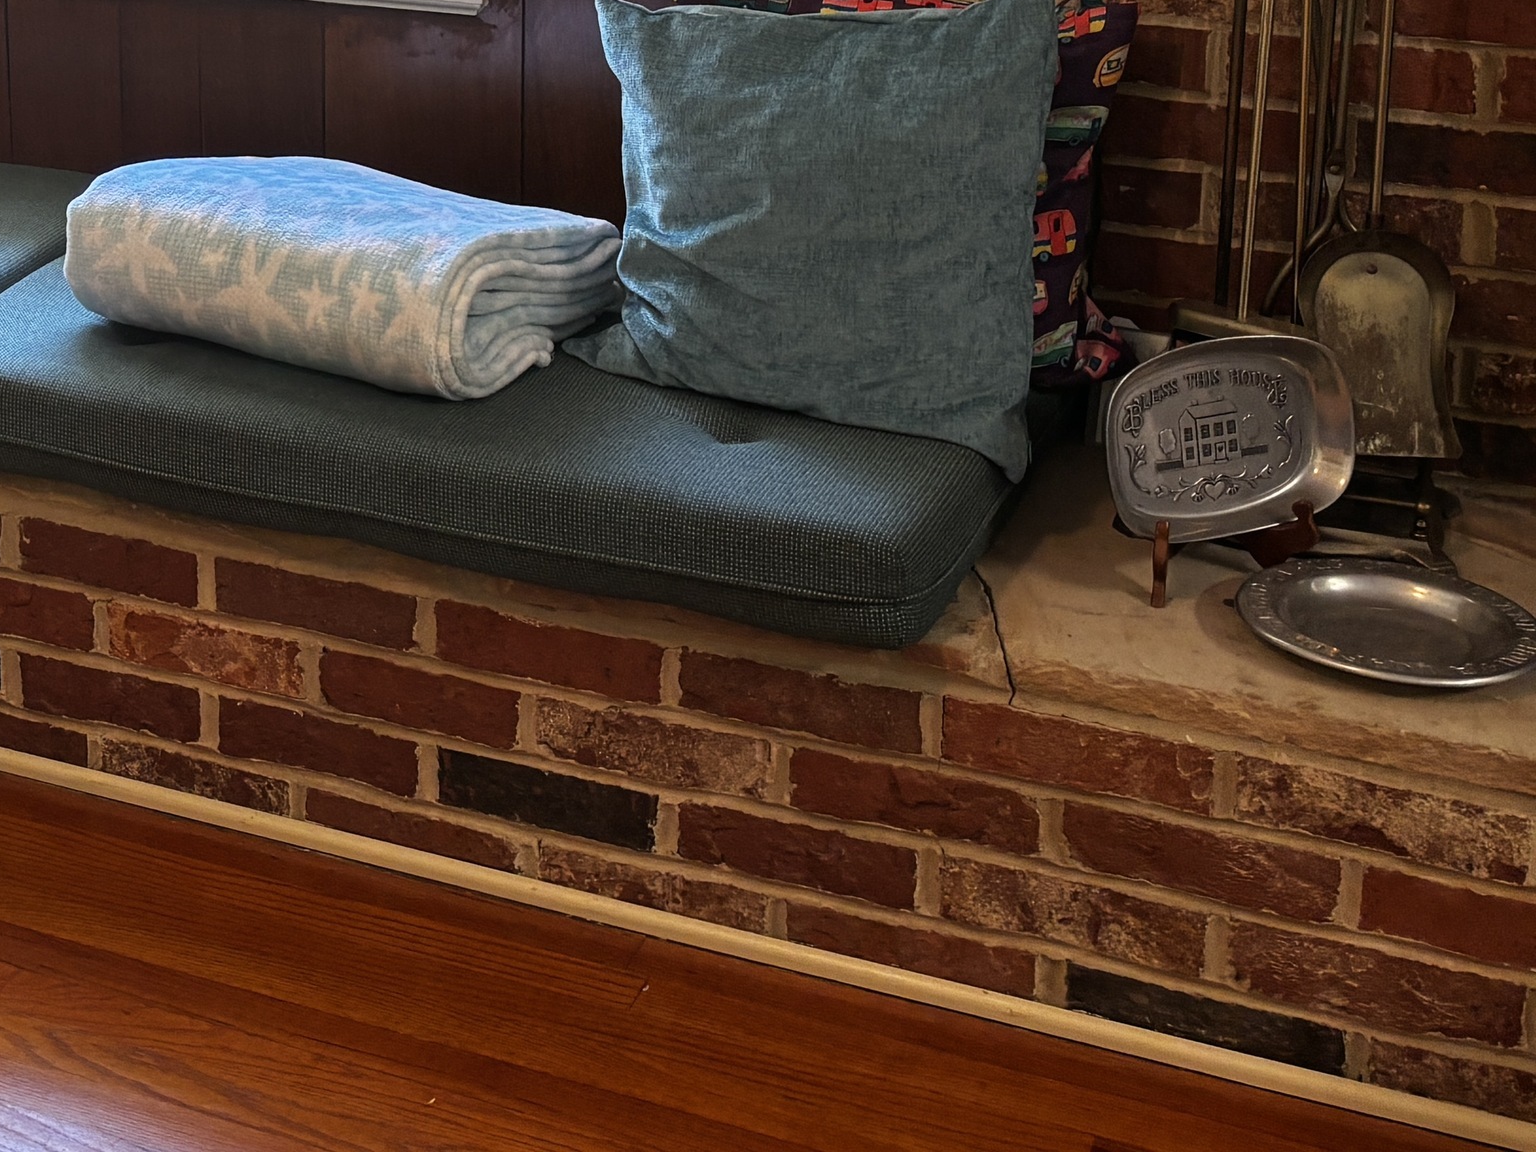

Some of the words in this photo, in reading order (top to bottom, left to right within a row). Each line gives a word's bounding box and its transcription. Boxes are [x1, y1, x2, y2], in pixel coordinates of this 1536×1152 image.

[1122, 378, 1178, 438] BLESS
[1183, 369, 1220, 389] THIS
[1229, 368, 1287, 408] HOUSE
